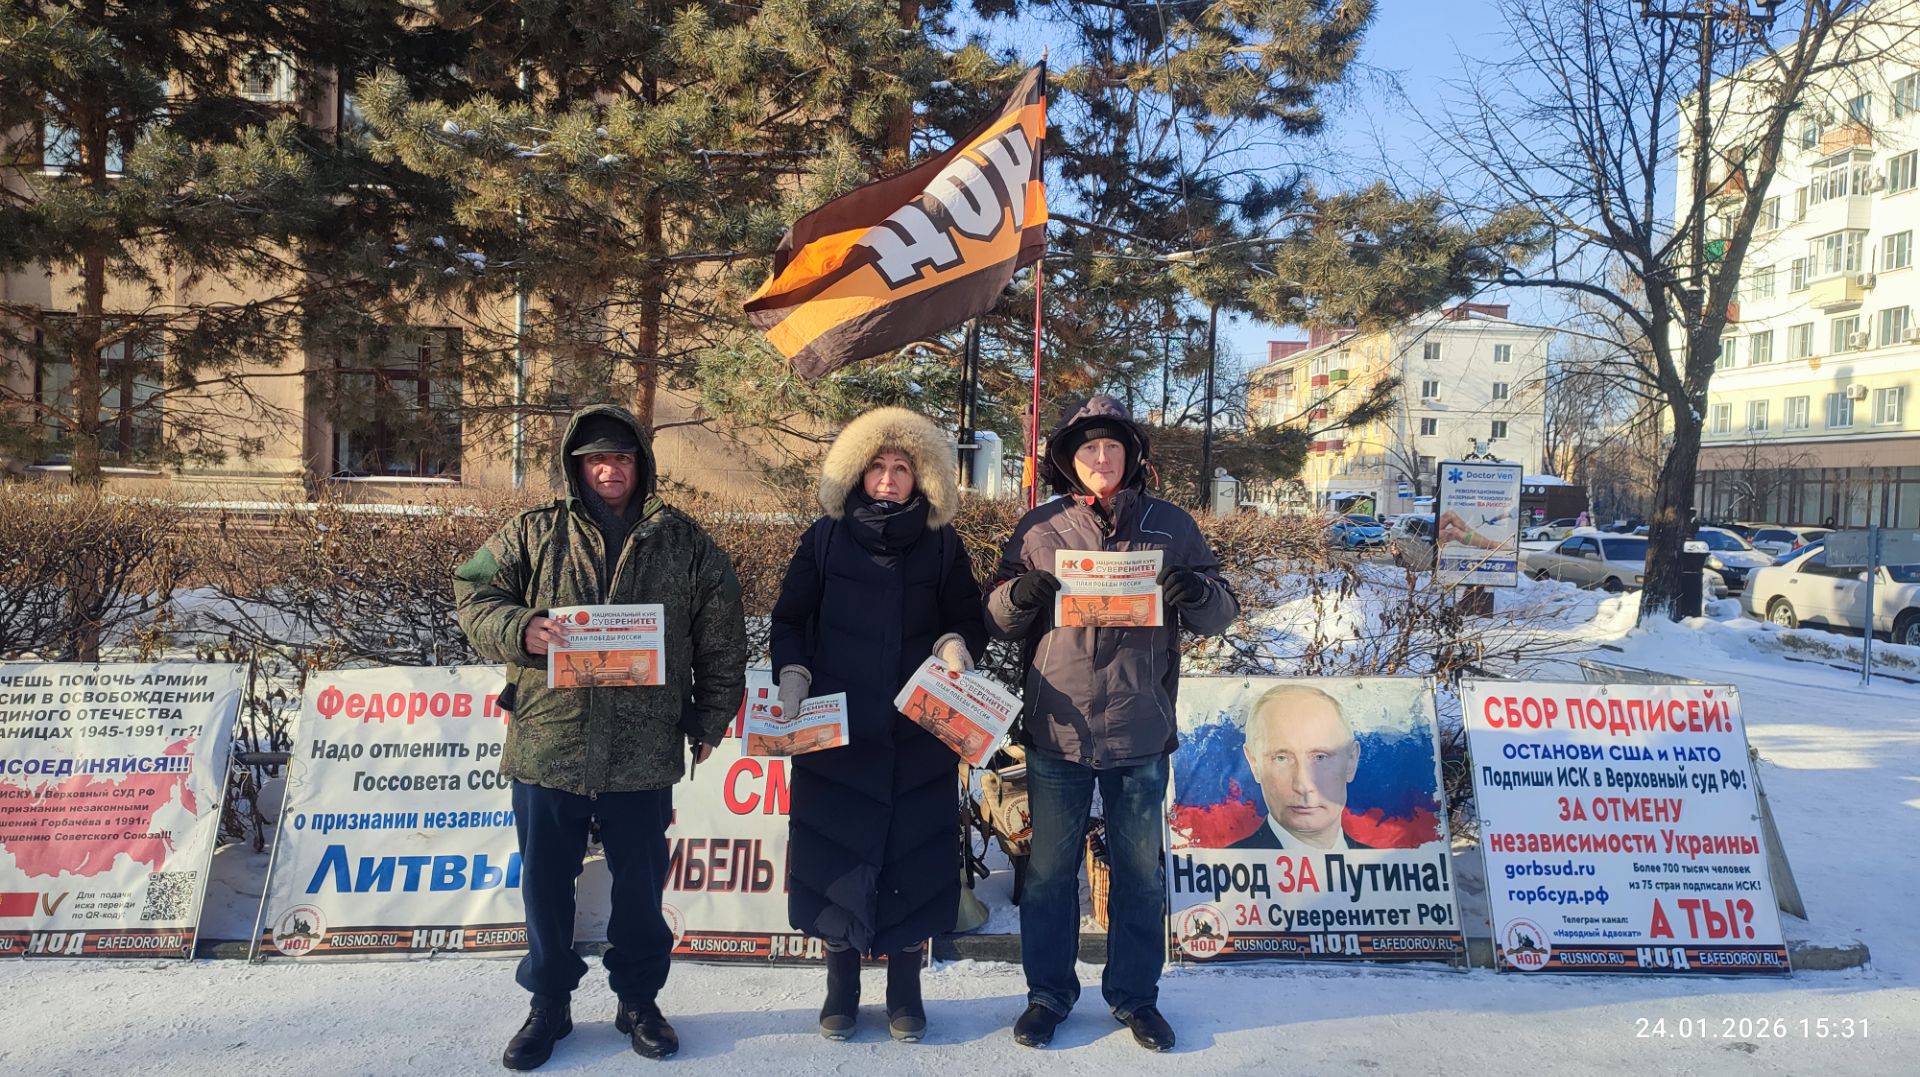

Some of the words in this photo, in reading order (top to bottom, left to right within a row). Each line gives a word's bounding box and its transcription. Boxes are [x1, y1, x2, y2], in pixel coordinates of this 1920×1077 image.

[1466, 471, 1496, 479] Doctor
[1062, 560, 1079, 569] НК
[1096, 564, 1156, 573] СУВЕРЕНИТЕТ
[555, 613, 573, 623] НК
[59, 674, 136, 686] ПОМОЧЬ
[141, 674, 208, 686] АРМИИ
[41, 693, 54, 704] В
[60, 691, 215, 704] ОСВОБОЖДЕНИИ
[316, 685, 472, 724] Федоров
[959, 680, 1011, 716] СУВЕРЕНИТЕТ
[77, 708, 183, 720] ОТЕЧЕСТВА
[752, 703, 768, 712] НК
[971, 703, 991, 720] РОССИИ
[1484, 696, 1558, 728] СБОР
[1565, 689, 1733, 736] ПОДПИСЕЙ!
[79, 724, 164, 737] 1945-1991
[171, 724, 203, 736] гг?!
[311, 740, 363, 761] Надо
[369, 742, 469, 758] отменить
[476, 742, 506, 761] ре
[1503, 743, 1604, 760] ОСТАНОВИ
[1609, 745, 1654, 760] США
[1657, 749, 1669, 760] и
[1673, 746, 1721, 762] НАТО
[353, 770, 460, 791] Госсовета
[467, 769, 513, 790] ССС
[1482, 766, 1554, 790] Подпиши
[1556, 766, 1590, 787] ИСК
[1594, 771, 1603, 787] в
[1605, 764, 1688, 793] Верховный
[1691, 773, 1719, 794] суд
[1720, 768, 1747, 790] РФ!
[45, 790, 109, 800] Верховный
[112, 789, 135, 797] СУД
[138, 788, 156, 796] РФ
[1, 805, 66, 814] признании
[69, 804, 149, 812] незаконными
[1558, 796, 1588, 821] ЗА
[1592, 797, 1683, 822] ОТМЕНУ
[41, 817, 101, 828] Горбачёва
[115, 816, 150, 825] 1991г.
[294, 813, 306, 831] о
[311, 812, 418, 834] признании
[423, 810, 516, 829] независи
[0, 833, 51, 843] ушению
[54, 831, 119, 841] Советского
[123, 830, 172, 840] Союза!!!
[1490, 833, 1657, 854] независимости
[1660, 829, 1760, 860] Украины
[305, 845, 522, 894] Литвы
[1504, 859, 1596, 879] gorbsud.ru
[1633, 862, 1661, 873] Более
[1662, 863, 1680, 873] 700
[1681, 864, 1709, 874] тысяч
[1711, 864, 1751, 874] человек
[1172, 853, 1271, 902] Народ
[1276, 855, 1320, 893] ЗА
[1324, 853, 1450, 902] Путина!
[1628, 881, 1640, 890] из
[1641, 880, 1653, 890] 75
[1655, 881, 1681, 892] стран
[1683, 882, 1734, 891] подписали
[1735, 880, 1762, 891] ИСК!
[76, 891, 95, 899] Для
[1508, 885, 1610, 905] горбсуд.рф
[1235, 903, 1263, 926] ЗА
[1268, 903, 1411, 932] Суверенитет
[1417, 903, 1454, 925] РФ!
[1562, 915, 1600, 925] Телеграм
[1649, 897, 1675, 938] А
[1677, 898, 1755, 939] ТЫ?
[411, 928, 465, 950] НОД
[475, 930, 528, 944] EAFEDOR
[1553, 927, 1600, 939] «Народный
[1602, 929, 1642, 939] Адвокат»
[28, 932, 87, 955] НОД
[97, 935, 183, 950] EAFEDOROV.RU
[283, 939, 311, 950] НОД
[330, 934, 398, 947] RUSNOD.RU
[690, 939, 757, 952] RUSNOD.RU
[770, 935, 822, 960] НОД
[1190, 940, 1217, 952] НОД
[1233, 938, 1297, 951] RUSNOD.RU
[1309, 934, 1362, 955] НОД
[1372, 937, 1453, 950] EAFEDOROV.RU
[1516, 953, 1543, 965] НОД
[1559, 951, 1625, 966] RUSNOD.RU
[1636, 947, 1691, 970] НОД
[1699, 951, 1779, 966] EAFEDOROV.RU
